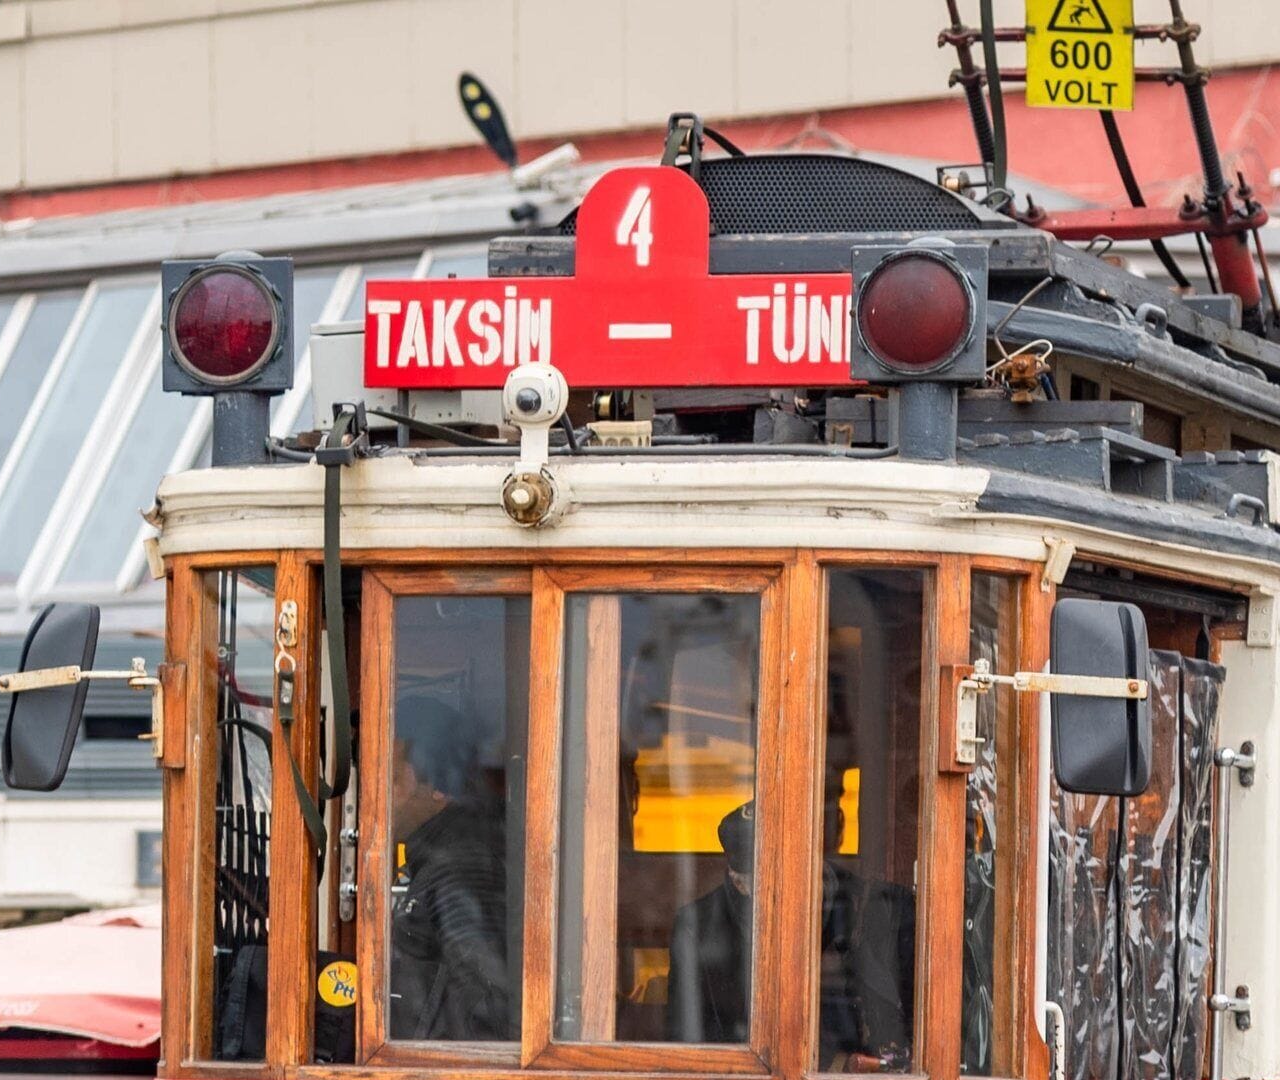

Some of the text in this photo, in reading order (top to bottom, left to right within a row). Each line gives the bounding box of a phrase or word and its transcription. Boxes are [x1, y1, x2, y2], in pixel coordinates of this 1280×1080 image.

[1050, 39, 1112, 71] 600
[1044, 79, 1119, 105] VOLT
[616, 186, 653, 267] 4
[367, 285, 552, 368] TAKSİM
